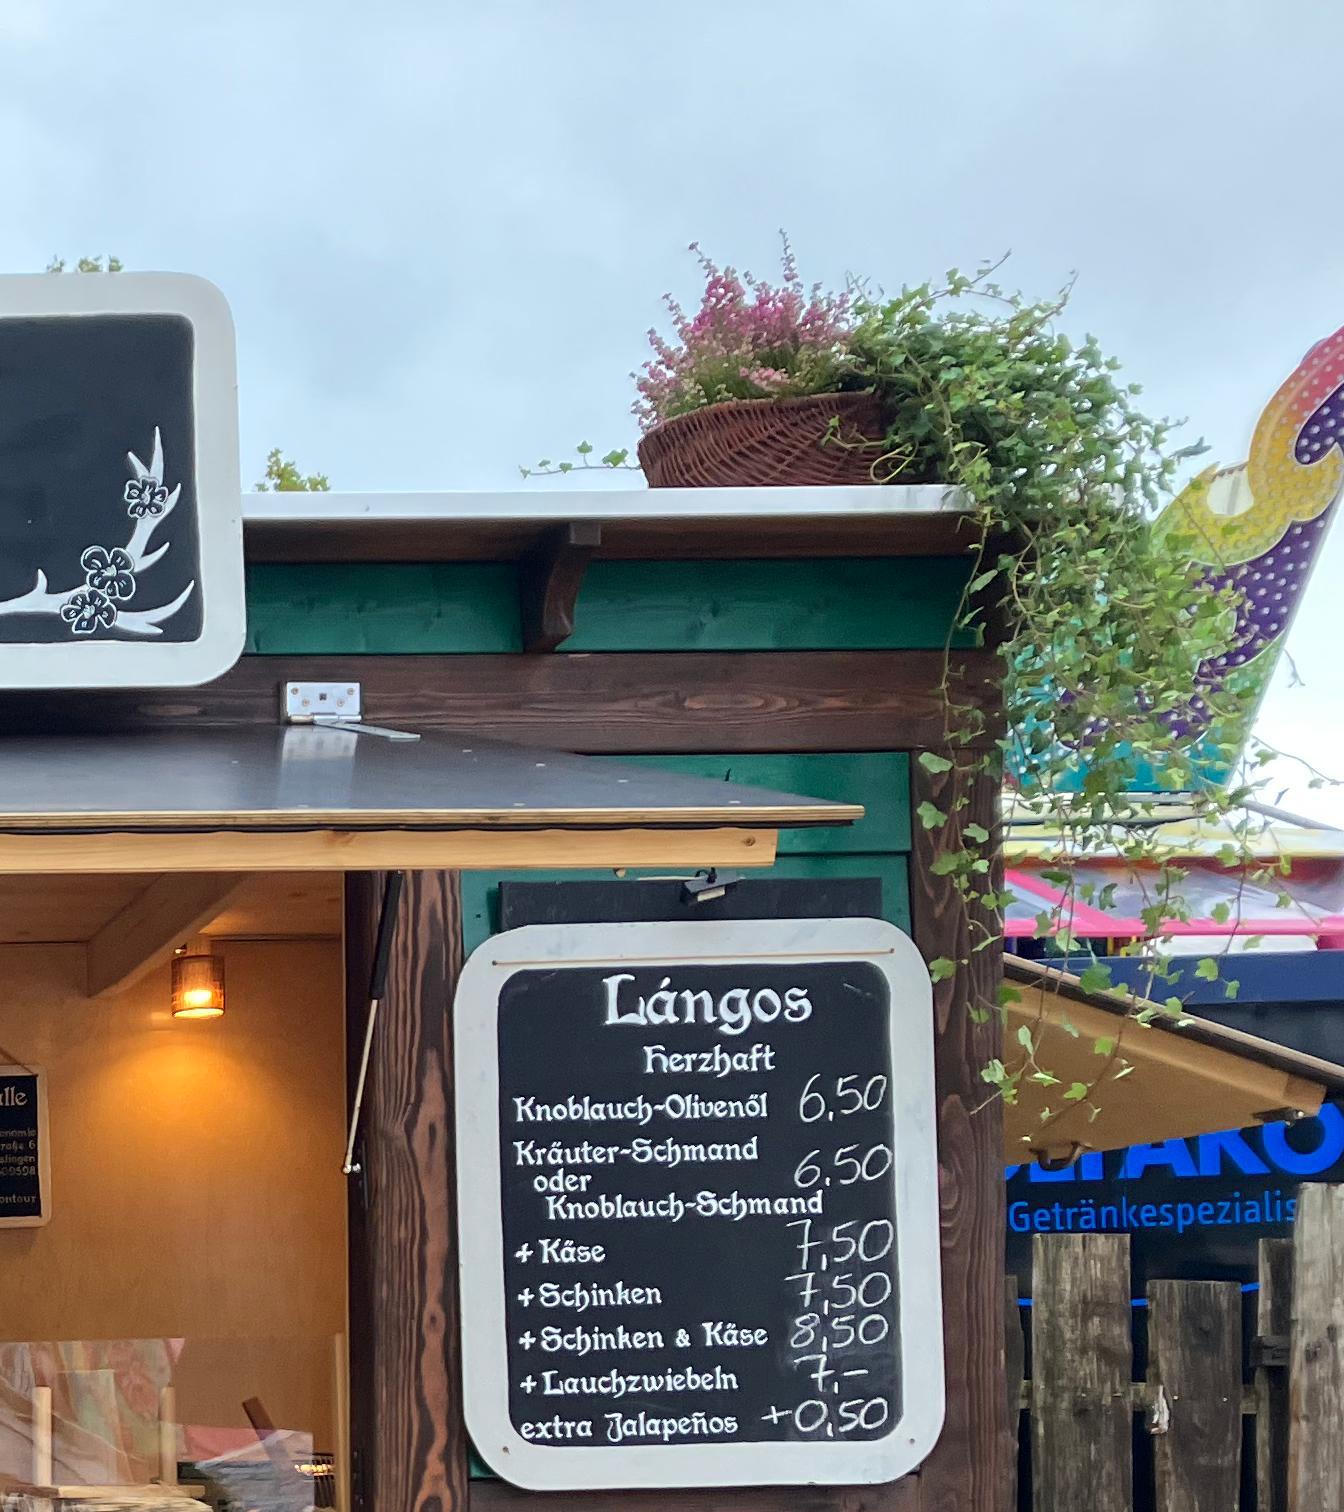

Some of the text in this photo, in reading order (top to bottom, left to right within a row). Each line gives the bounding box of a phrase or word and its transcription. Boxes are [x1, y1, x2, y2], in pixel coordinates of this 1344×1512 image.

[603, 974, 812, 1035] Lángos
[644, 1046, 775, 1078] Herzhaft
[513, 1074, 887, 1126] Knoblauch-Olivenöl 6,50
[513, 1137, 892, 1188] Kräuter-Schmand 6,50
[534, 1171, 591, 1193] oder
[548, 1191, 822, 1222] Knoblauch-Schmand
[541, 1240, 605, 1264] Käse
[786, 1219, 892, 1272] 7,50
[785, 1272, 891, 1314] 7,50
[676, 1329, 690, 1347] &
[703, 1322, 768, 1346] Käse
[789, 1312, 888, 1352] 8,50
[521, 1396, 888, 1442] extra Jalapeños +0,50
